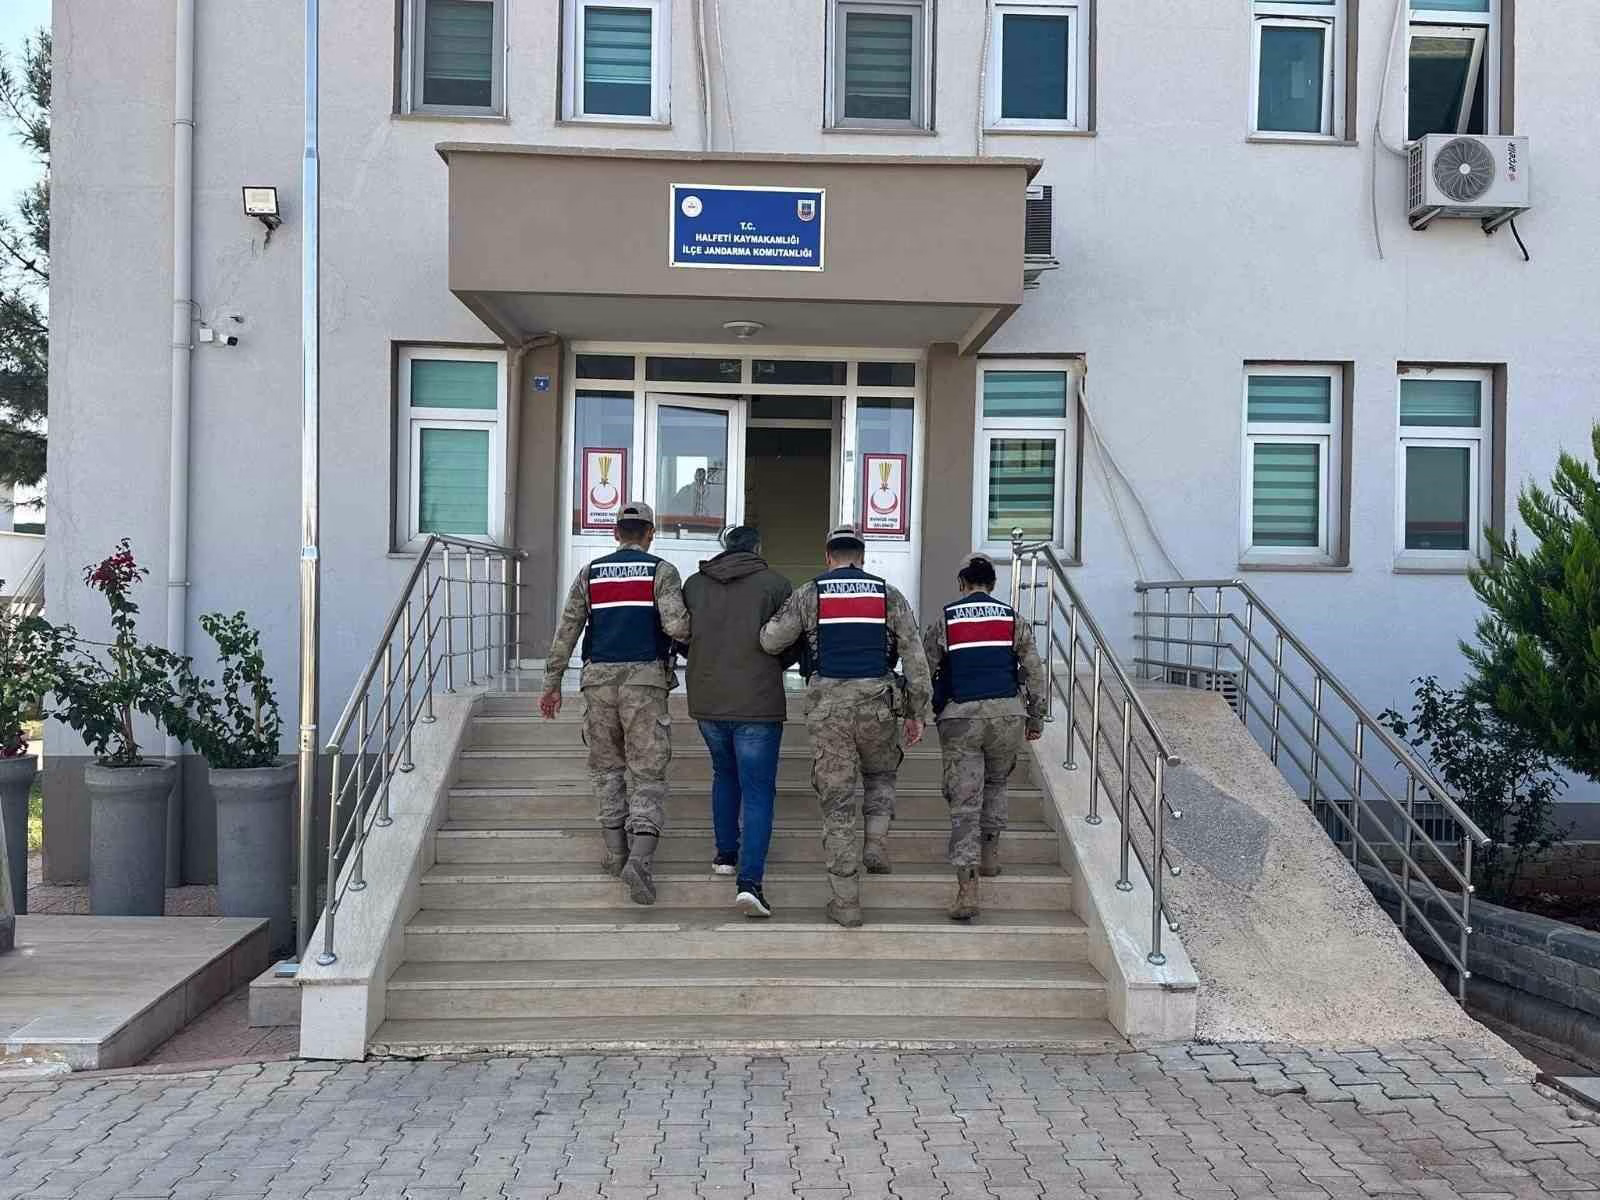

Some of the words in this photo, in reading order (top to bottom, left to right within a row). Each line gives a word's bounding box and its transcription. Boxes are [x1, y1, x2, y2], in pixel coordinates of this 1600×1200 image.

[740, 222, 756, 231] T.C.
[695, 233, 732, 243] HALFETİ
[733, 234, 800, 244] KAYMAKAMLIĞI
[682, 245, 702, 256] İLÇE
[704, 247, 751, 256] JANDARMA
[753, 247, 813, 258] KOMUTANLIĞI
[597, 566, 649, 577] JANDARMA
[824, 583, 878, 593] JANDARMA
[953, 606, 1007, 618] JANDARMA
